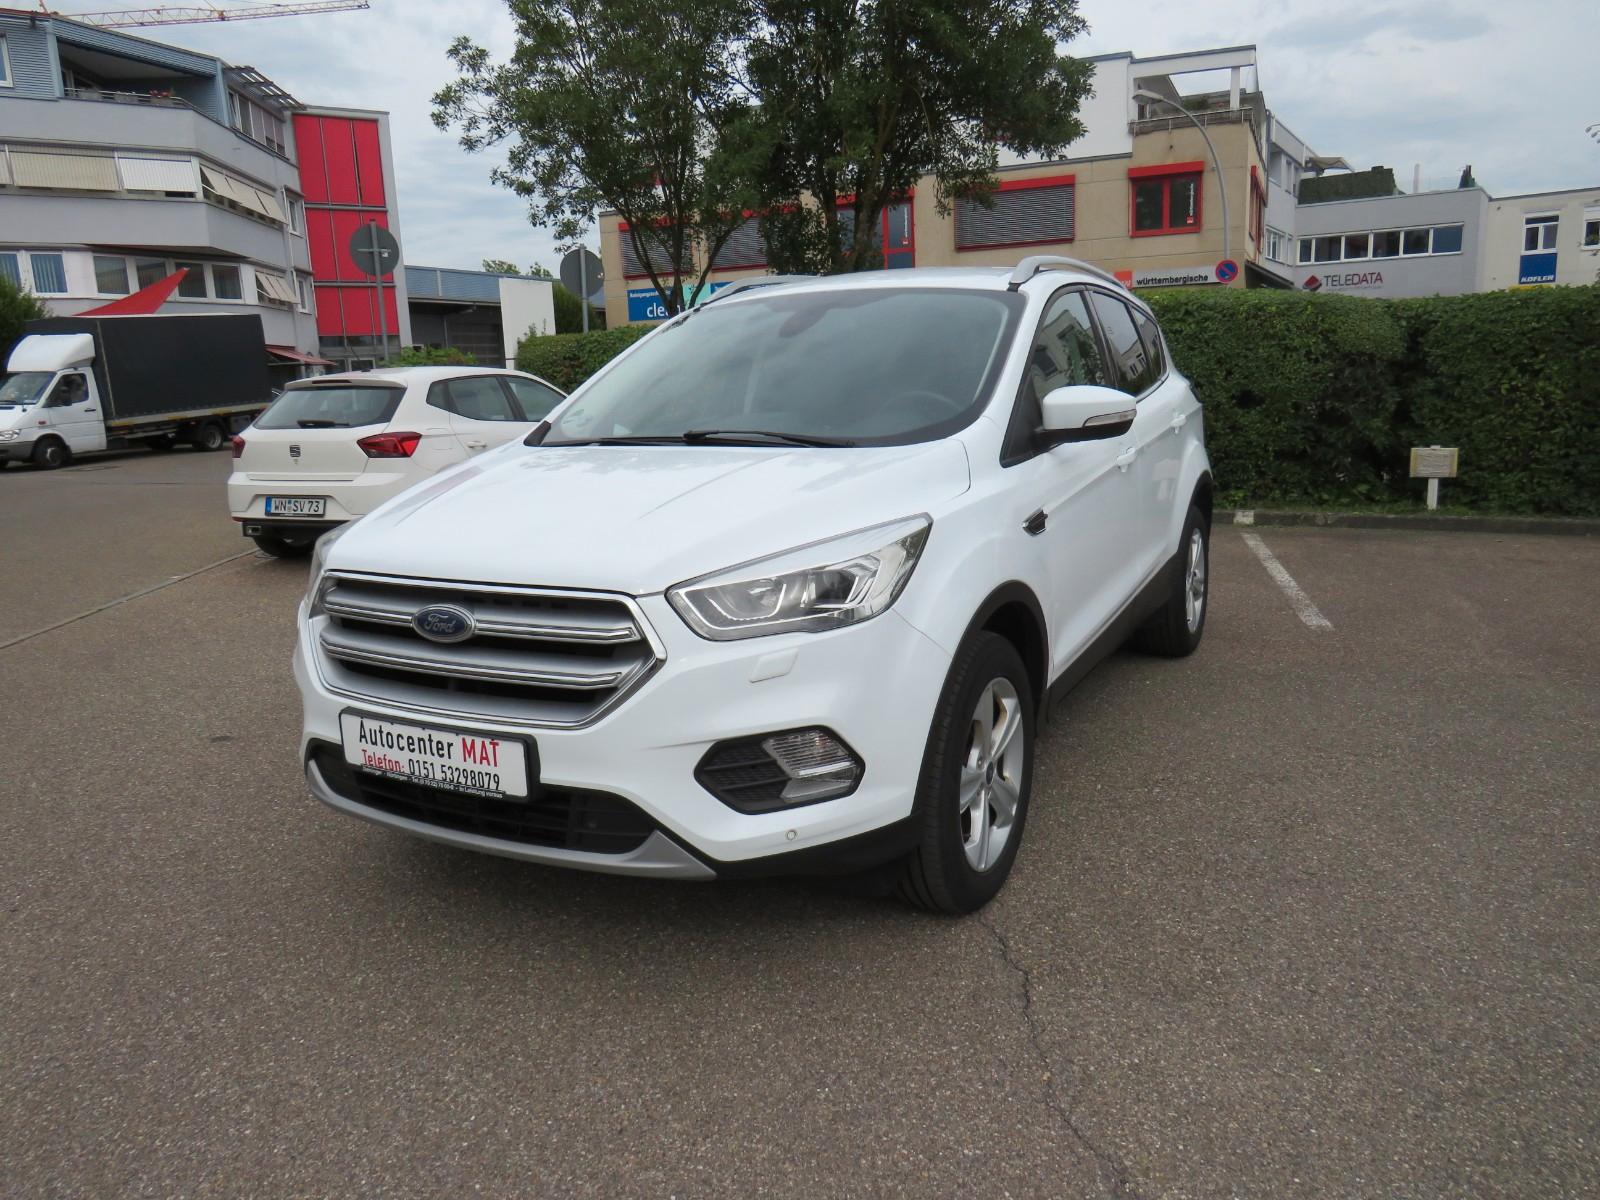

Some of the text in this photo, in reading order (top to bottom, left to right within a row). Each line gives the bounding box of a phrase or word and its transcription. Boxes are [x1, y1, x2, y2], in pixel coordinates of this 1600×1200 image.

[1136, 274, 1209, 286] württembergische
[1323, 272, 1384, 287] TELEDATA
[1521, 275, 1555, 283] KOFLER
[308, 500, 320, 512] 73
[424, 614, 457, 633] Ford
[360, 720, 500, 768] Autocenter MAT
[361, 749, 406, 773] Telefon:
[408, 758, 436, 779] 0151
[440, 764, 501, 791] 53298079
